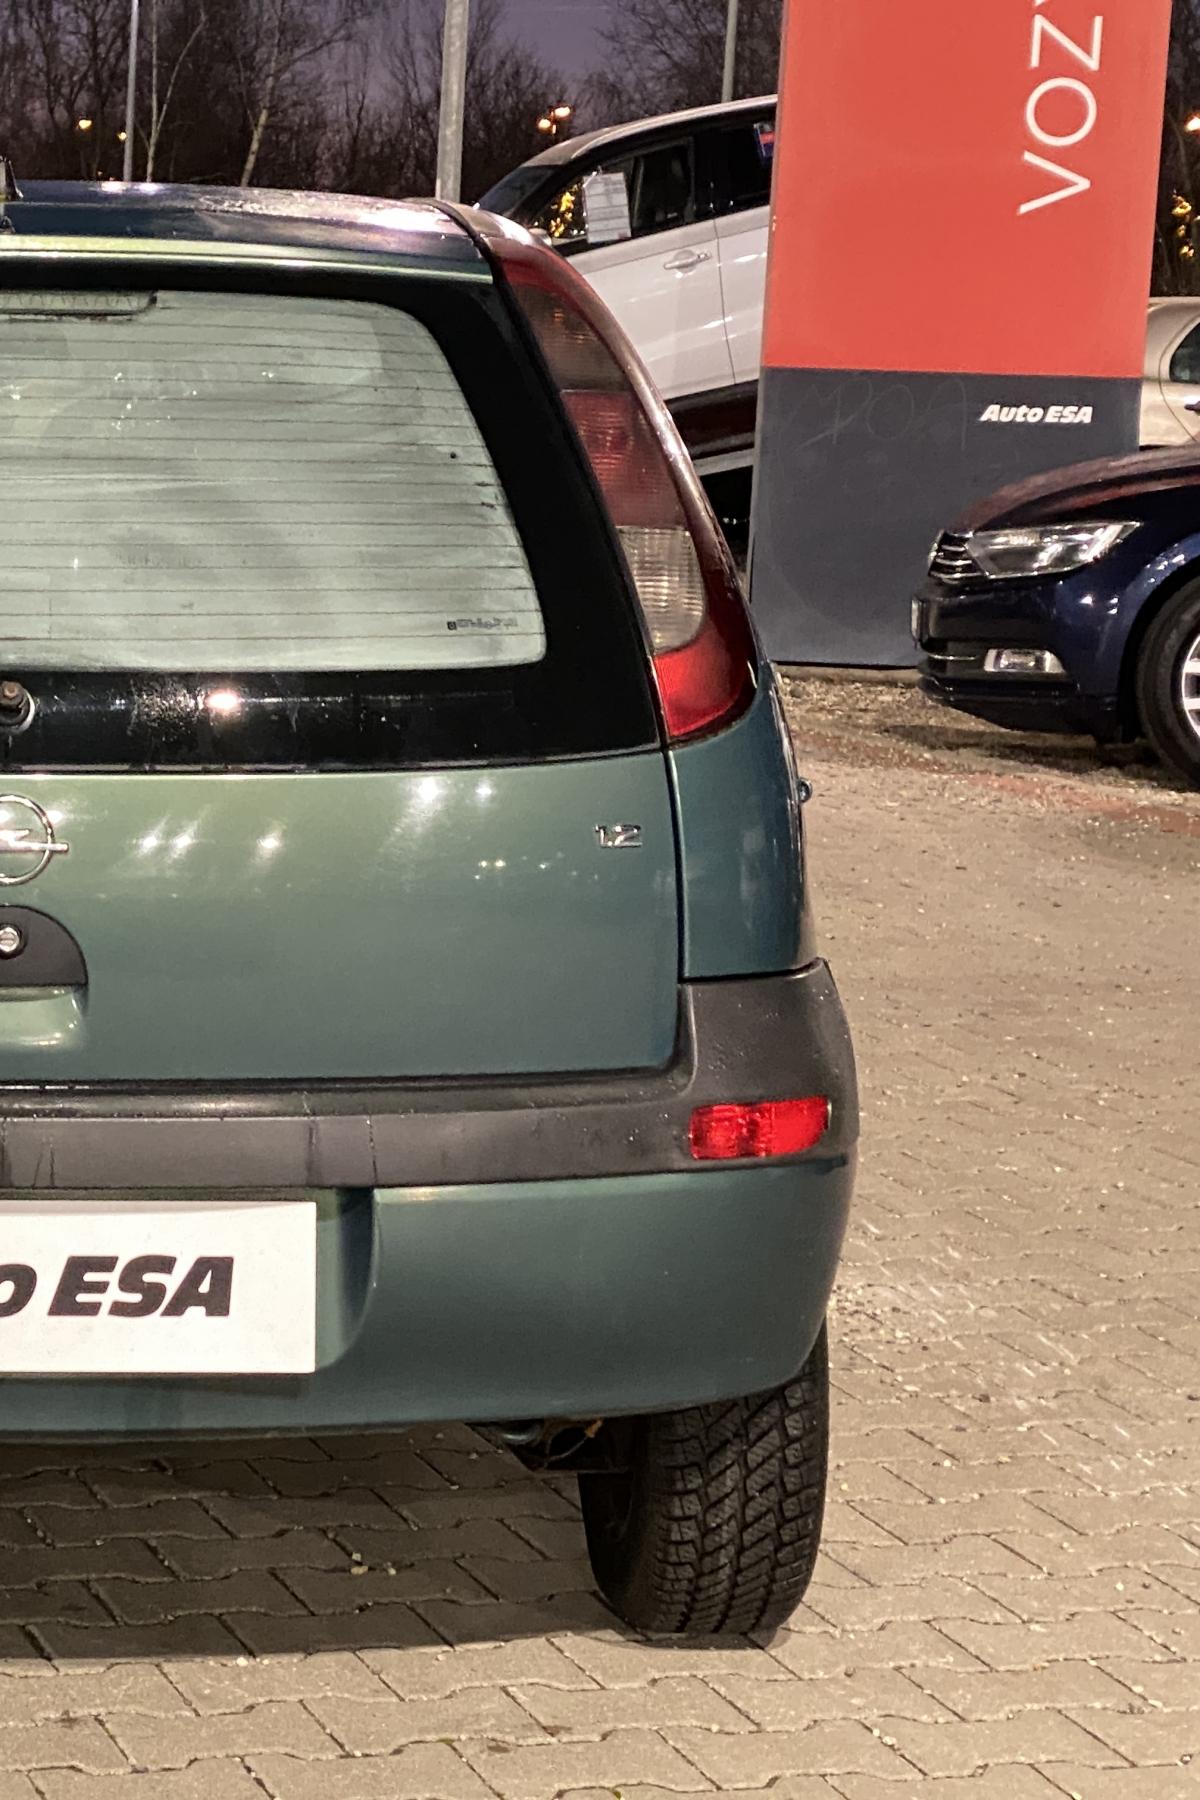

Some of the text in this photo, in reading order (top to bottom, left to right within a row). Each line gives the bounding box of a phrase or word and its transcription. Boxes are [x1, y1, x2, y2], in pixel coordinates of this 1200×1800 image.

[1016, 0, 1103, 215] VOZ
[978, 404, 1094, 424] Auto ESA
[594, 823, 643, 848] 1.2
[47, 1255, 235, 1318] ESA
